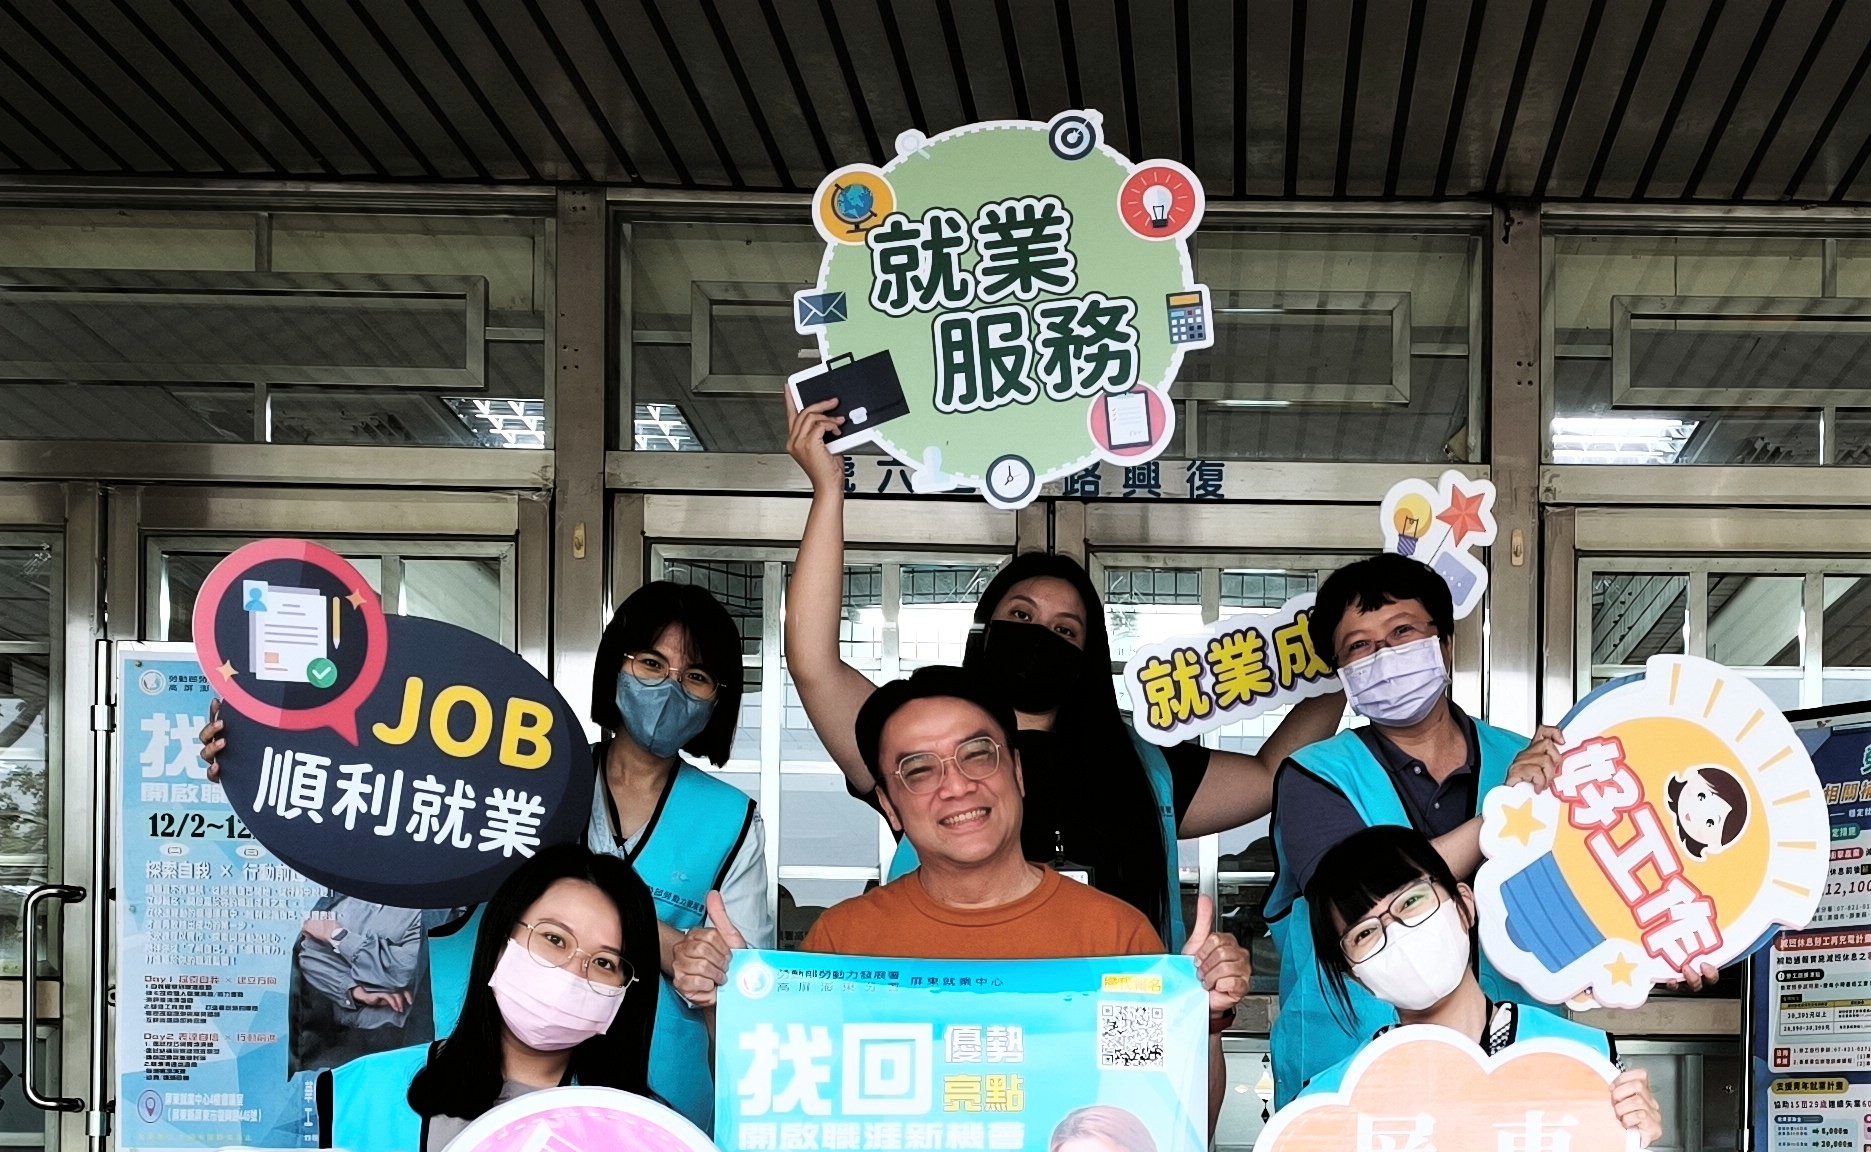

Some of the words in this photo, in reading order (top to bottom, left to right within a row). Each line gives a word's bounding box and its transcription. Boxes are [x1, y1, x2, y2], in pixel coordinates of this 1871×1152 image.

[871, 200, 1073, 309] 就業
[937, 297, 1136, 407] 服務
[372, 677, 554, 769] JOB
[252, 747, 545, 858] 順利就業
[1551, 736, 1723, 972] 好工作
[737, 1022, 934, 1117] 找回
[944, 1024, 1025, 1065] 優勢
[738, 1120, 1026, 1152] 開啟職涯新機會
[943, 1073, 1025, 1113] 亮點
